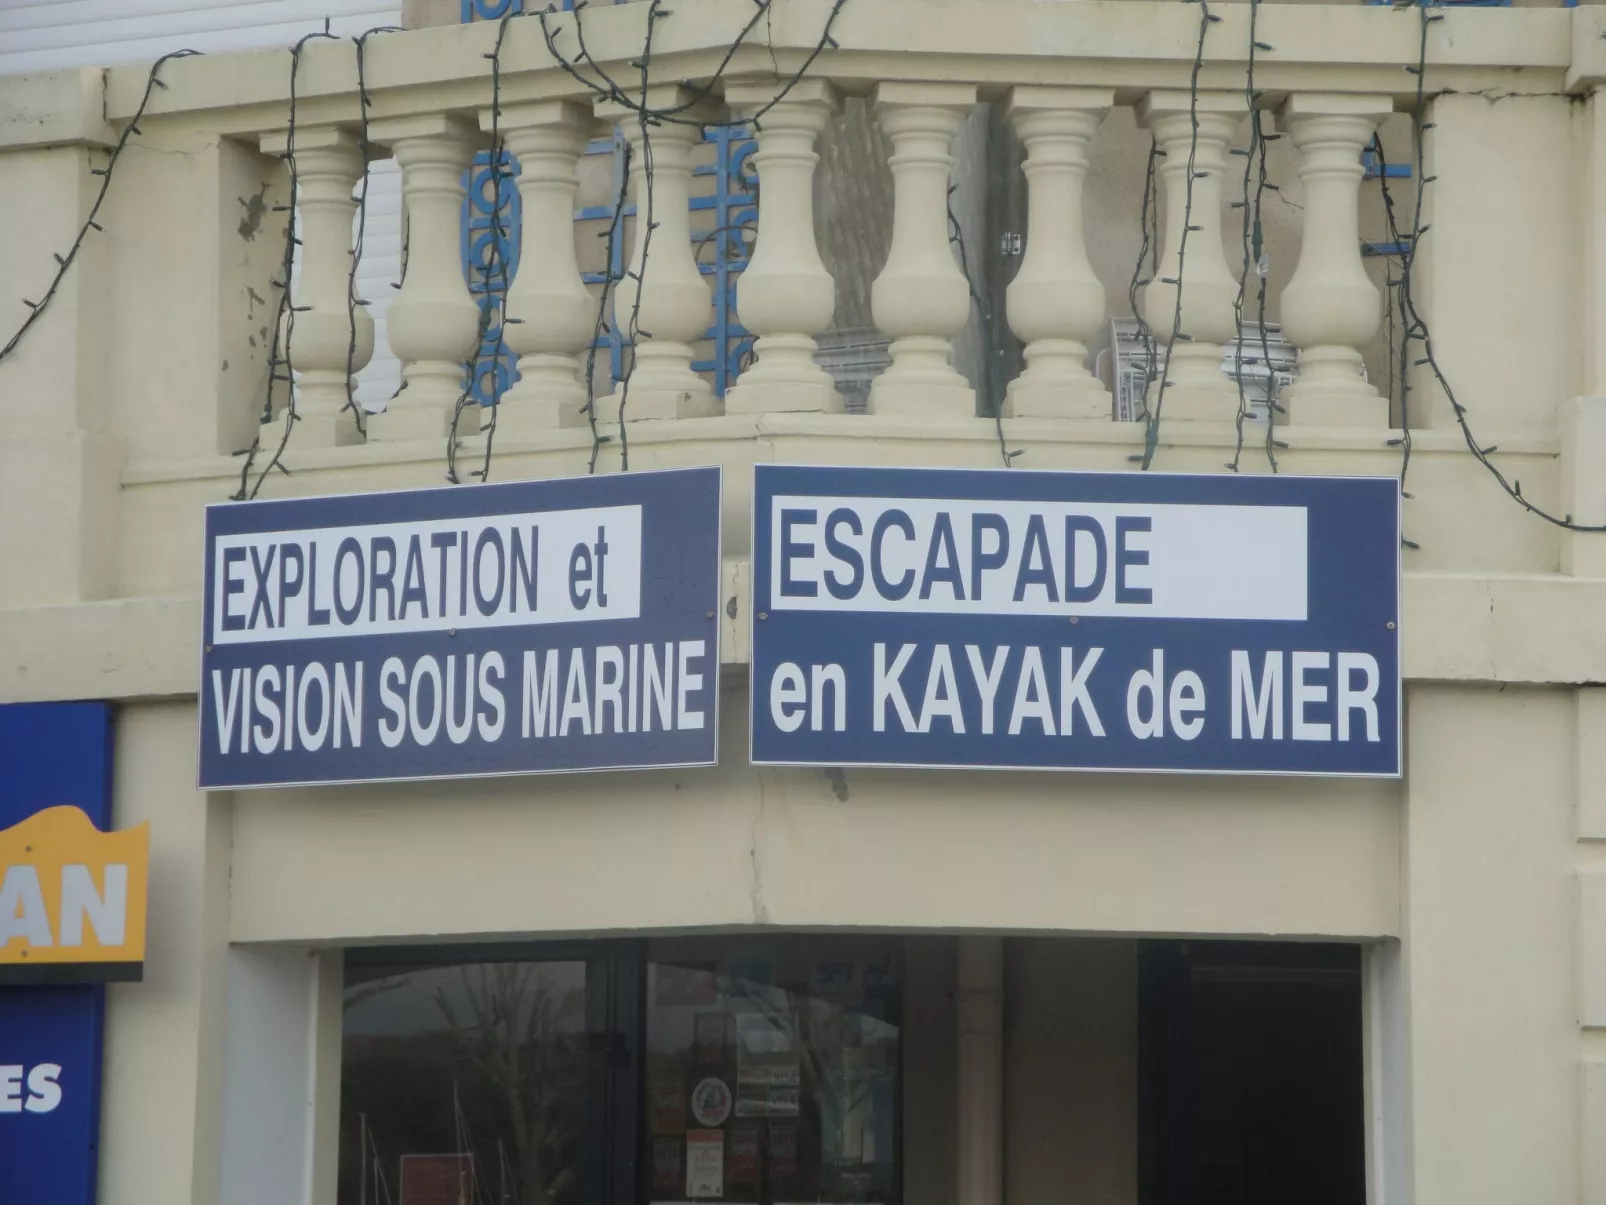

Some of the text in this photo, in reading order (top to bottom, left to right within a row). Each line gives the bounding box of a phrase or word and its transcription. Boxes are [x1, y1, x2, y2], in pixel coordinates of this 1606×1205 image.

[222, 525, 609, 632] EXPLORATION et
[779, 507, 1153, 605] ESCAPADE
[212, 639, 706, 755] VISION SOUS MARINE
[770, 643, 1381, 742] en KAYAK de MER
